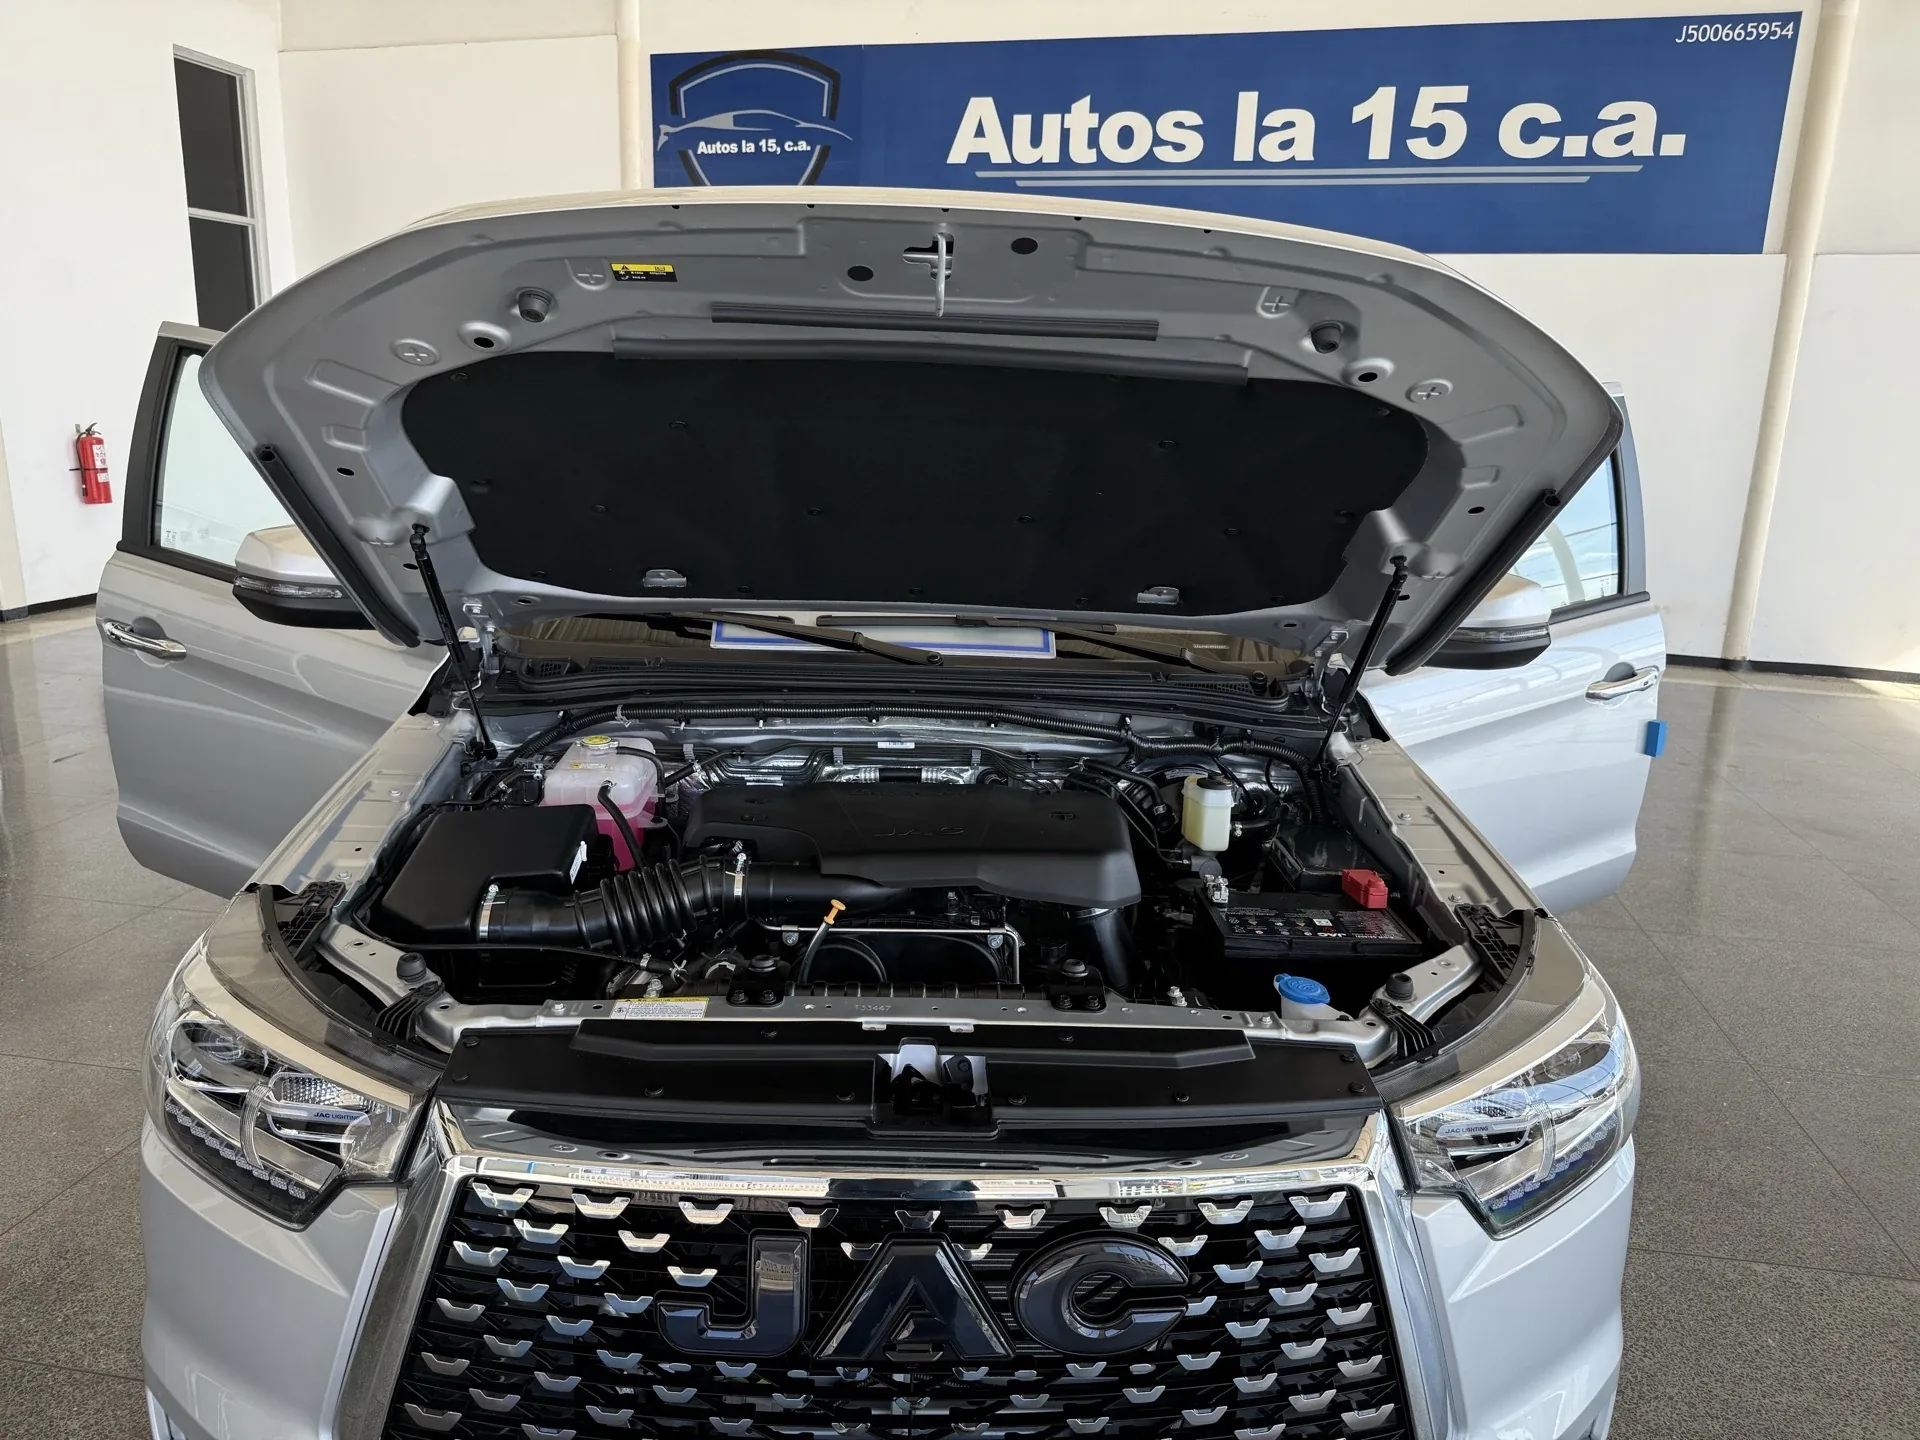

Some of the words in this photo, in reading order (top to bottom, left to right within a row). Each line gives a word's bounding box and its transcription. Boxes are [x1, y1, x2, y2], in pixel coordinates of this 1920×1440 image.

[1675, 21, 1795, 43] J500665954
[946, 95, 1204, 164] Autos
[1233, 91, 1316, 162] la
[1351, 85, 1469, 160] 15
[1498, 100, 1686, 159] c.a.
[697, 141, 738, 154] Autos
[741, 139, 755, 153] la
[759, 139, 780, 155] 15,
[784, 140, 811, 152] c.a.
[1461, 1125, 1489, 1133] LIGHTING
[657, 1230, 1190, 1360] JAC
